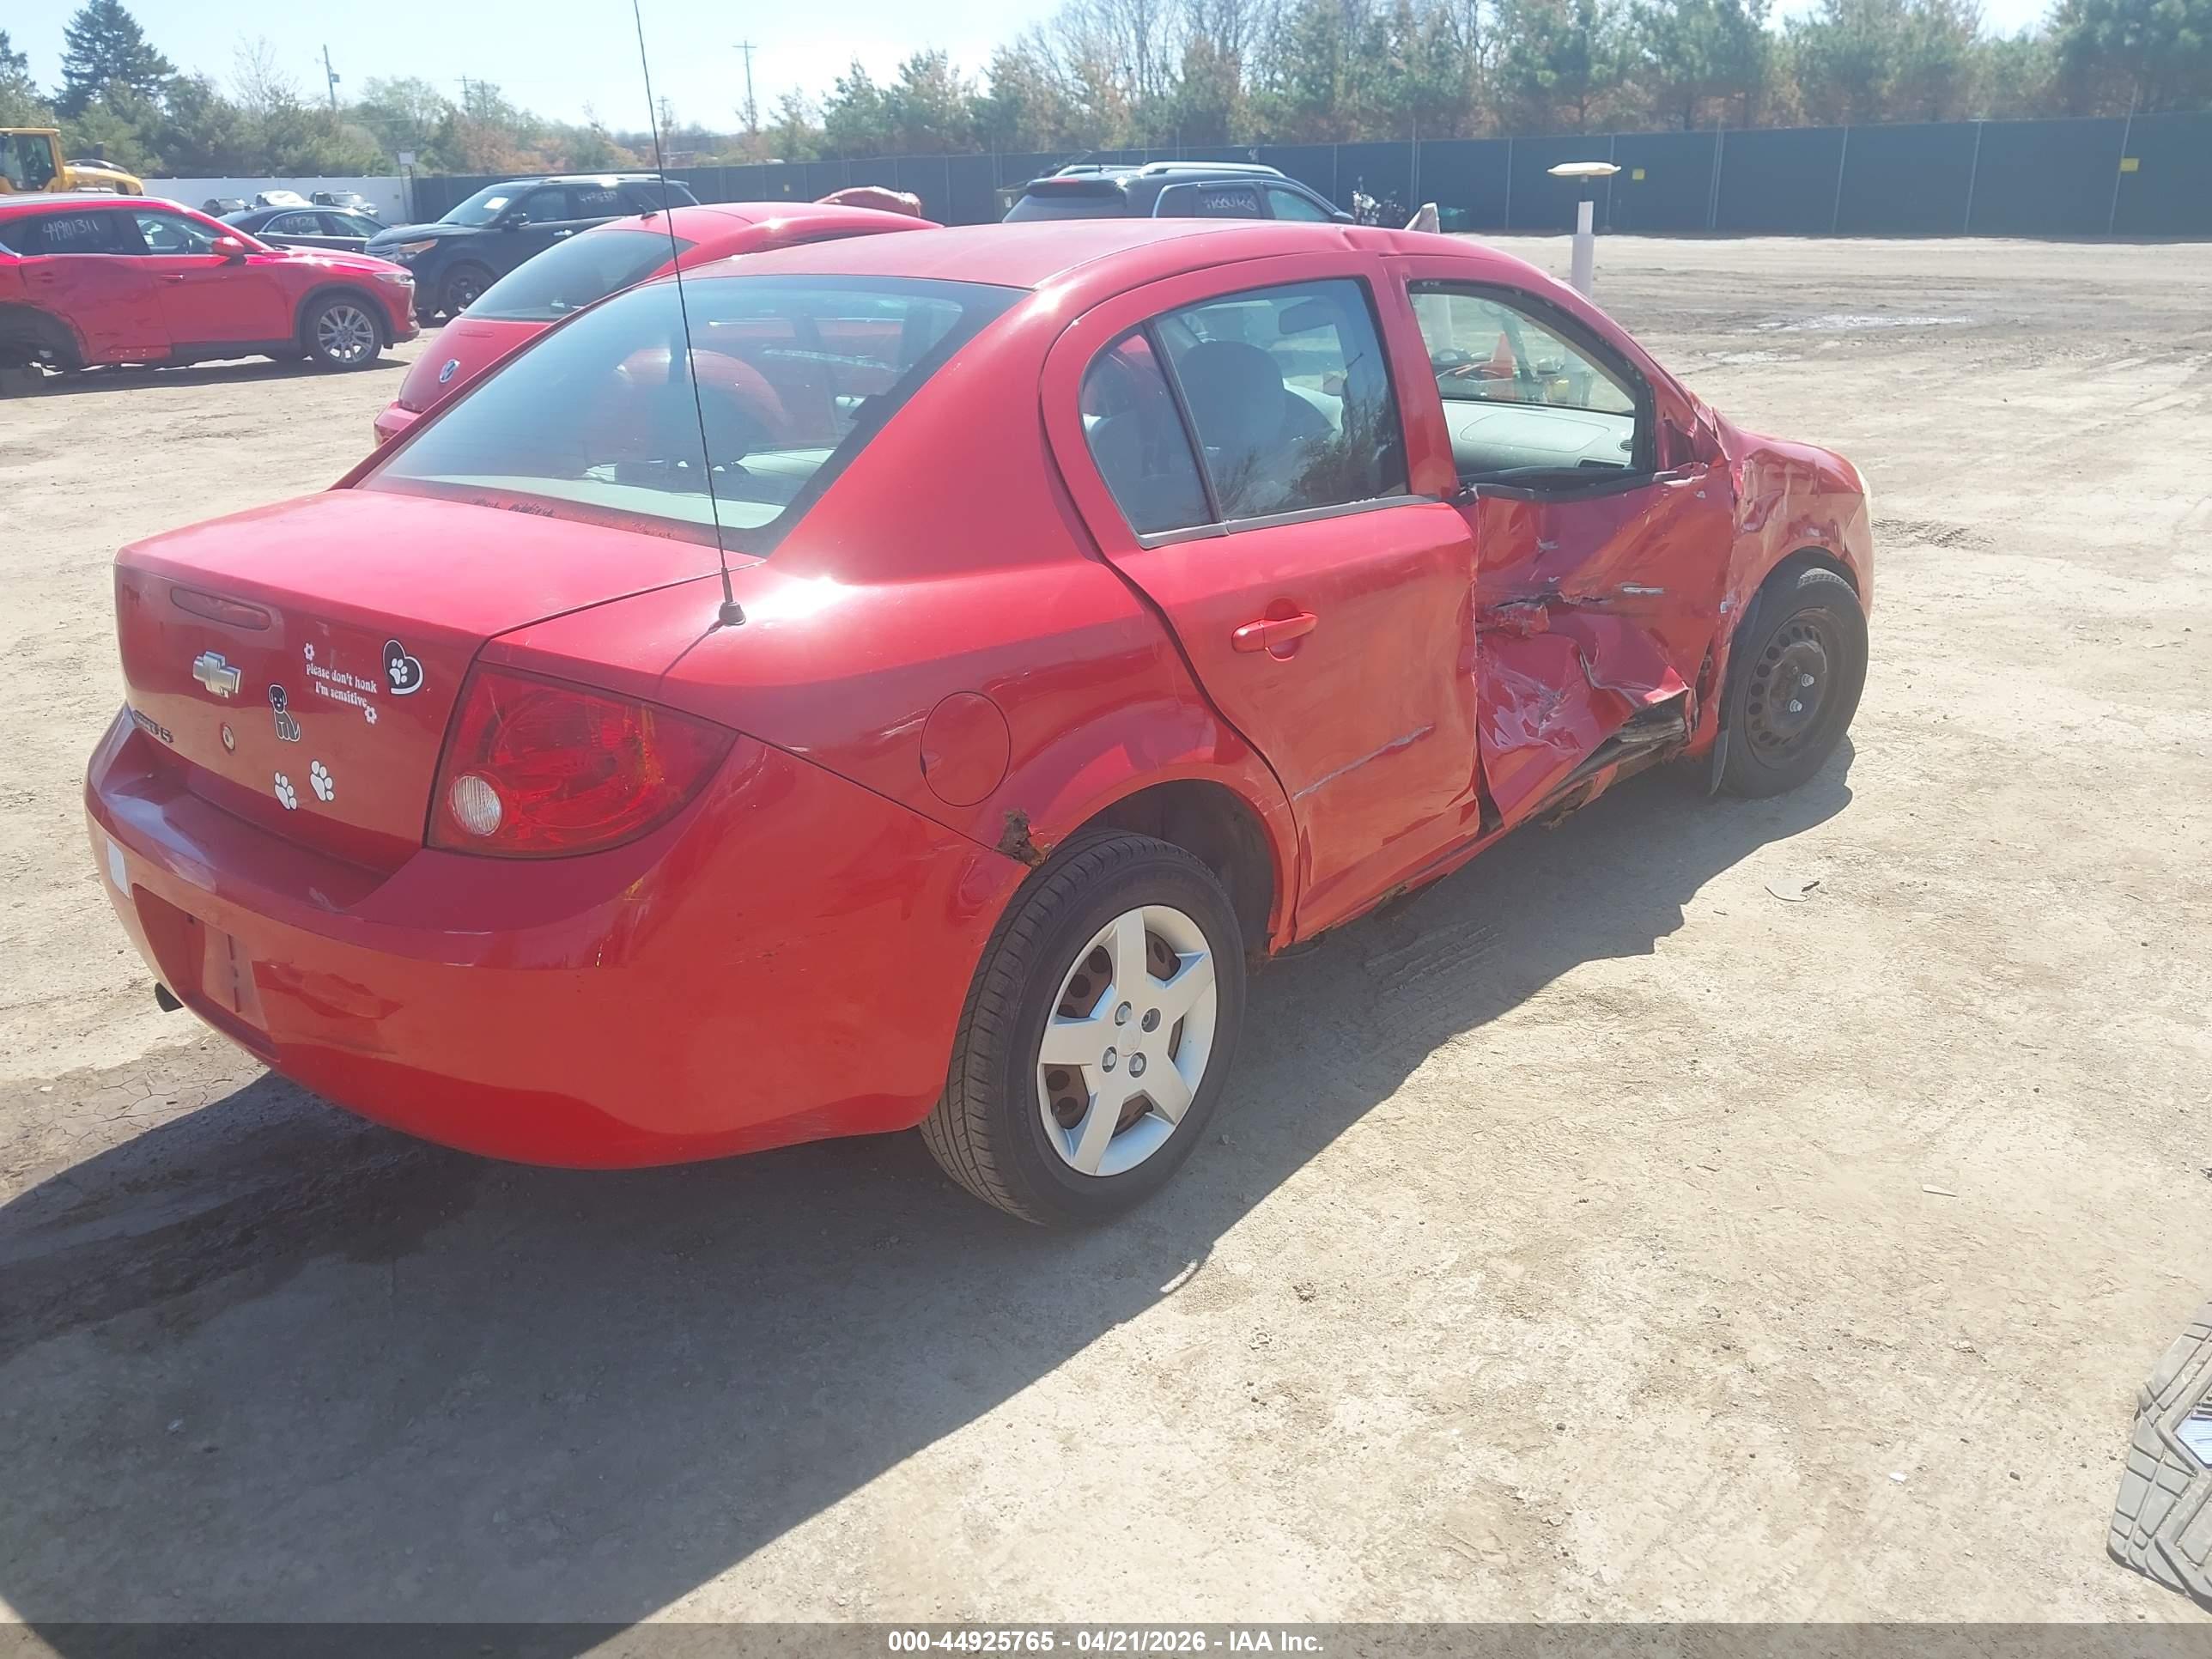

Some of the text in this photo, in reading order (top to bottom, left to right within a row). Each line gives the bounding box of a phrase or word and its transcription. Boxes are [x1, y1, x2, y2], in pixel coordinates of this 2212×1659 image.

[315, 681, 368, 708] I'm sensitive
[331, 670, 353, 687] don't
[355, 676, 378, 694] honk
